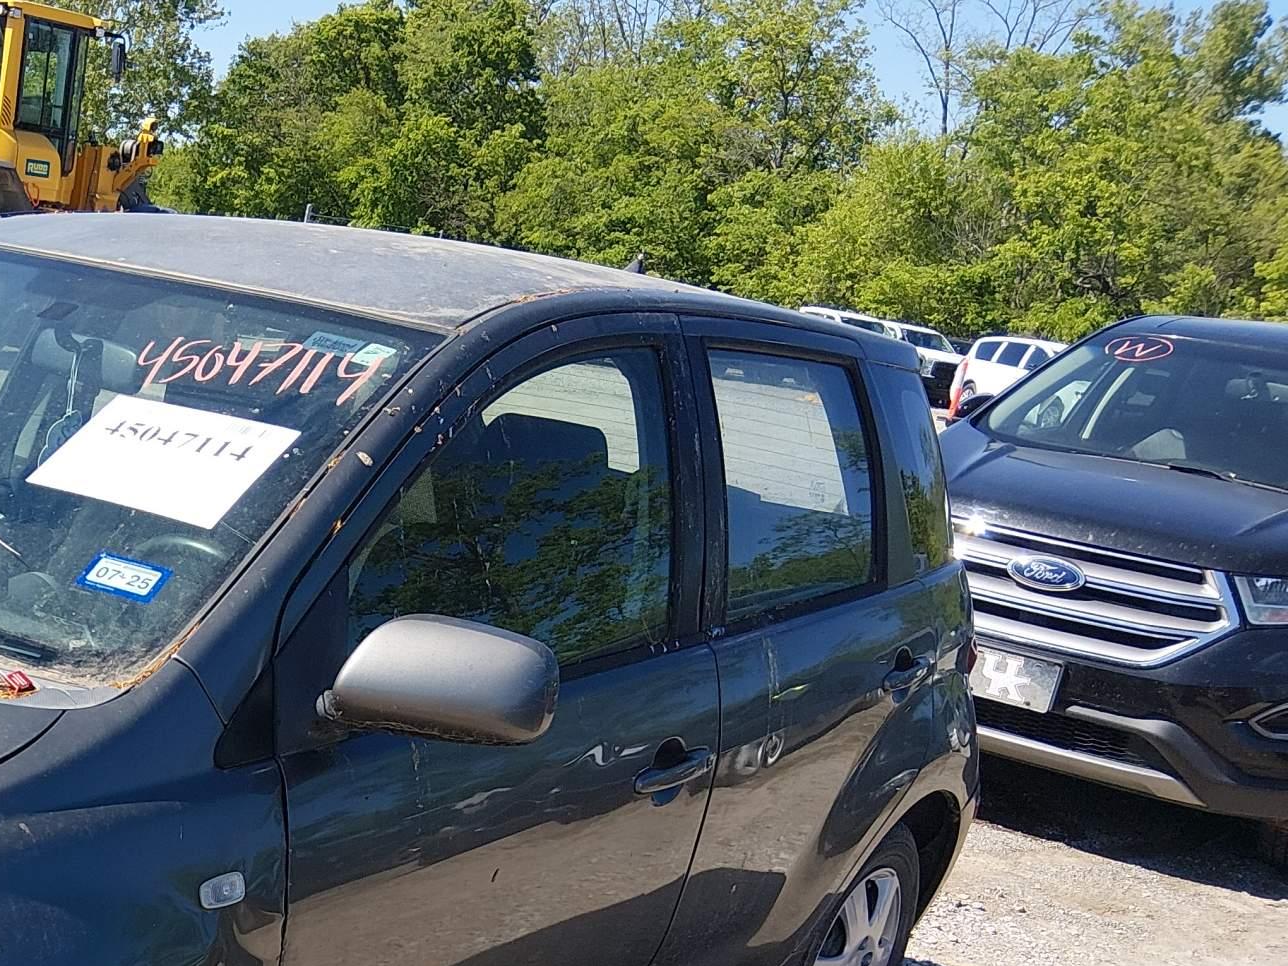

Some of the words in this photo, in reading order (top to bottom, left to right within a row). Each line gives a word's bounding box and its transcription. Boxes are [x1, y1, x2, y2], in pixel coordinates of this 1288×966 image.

[138, 336, 385, 407] 45047114
[105, 420, 254, 461] 45047114
[1024, 561, 1066, 583] Ford
